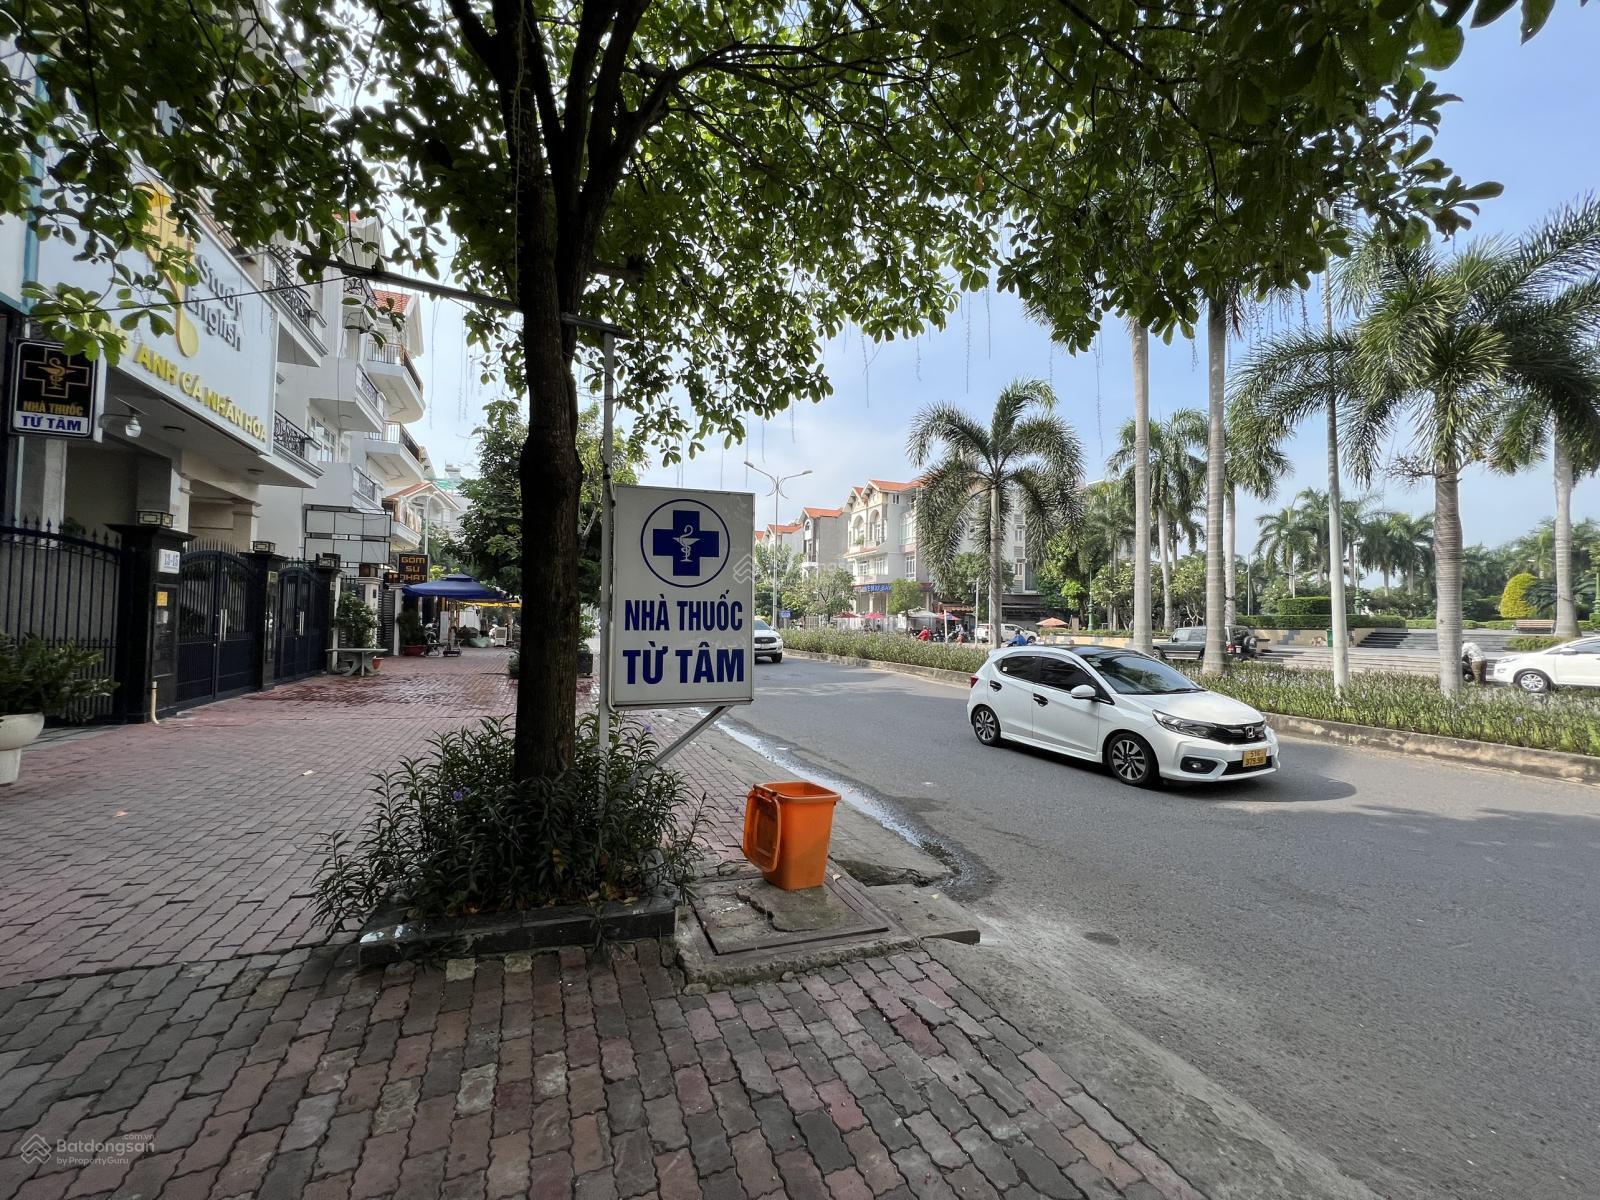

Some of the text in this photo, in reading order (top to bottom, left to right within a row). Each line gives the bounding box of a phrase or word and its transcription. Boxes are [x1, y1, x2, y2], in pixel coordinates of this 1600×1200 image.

[198, 254, 243, 321] Study
[184, 286, 241, 351] English
[133, 342, 178, 385] ANH
[21, 414, 82, 431] TỪ TÂM
[23, 400, 46, 412] NHÀ
[624, 590, 743, 631] NHÀ THUỐC
[622, 641, 744, 685] TỪ TÂM
